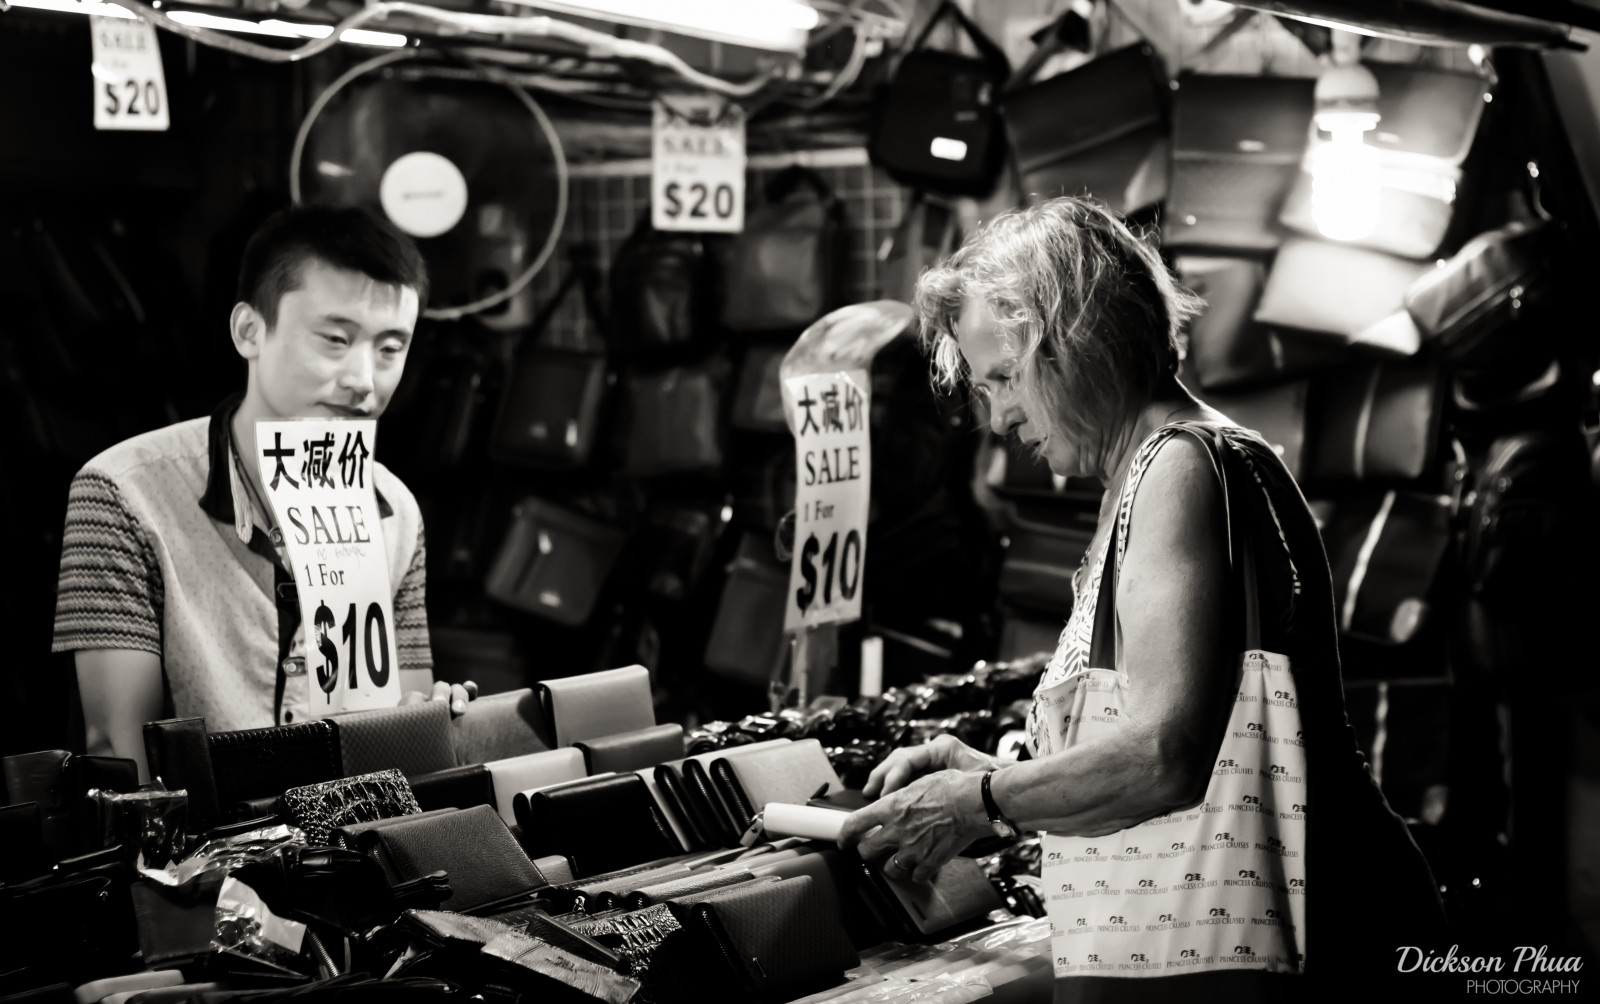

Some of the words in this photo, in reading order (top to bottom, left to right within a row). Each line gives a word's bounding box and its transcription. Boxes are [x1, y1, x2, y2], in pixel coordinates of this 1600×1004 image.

[104, 78, 161, 118] $20
[663, 182, 735, 220] $20
[797, 382, 865, 437] 大减价
[262, 430, 371, 492] 大减价
[804, 445, 862, 487] SALE
[814, 499, 835, 521] For
[286, 505, 371, 546] SALE
[304, 563, 314, 587] 1
[317, 563, 345, 586] For
[796, 528, 861, 619] $10
[313, 599, 391, 705] $10
[1232, 730, 1259, 739] PRINCESS
[1260, 733, 1281, 745] CRUISES
[1230, 767, 1254, 776] CRUISES
[1282, 774, 1303, 784] CRUISES
[1201, 805, 1223, 814] CRUISES
[1228, 804, 1254, 813] PRINCESS
[1279, 812, 1303, 821] PRINCESS
[1200, 842, 1225, 851] PRINCESS
[1225, 840, 1250, 850] CRUISES
[1125, 888, 1149, 896] PRINCESS
[1172, 882, 1197, 892] PRINCESS
[1223, 879, 1251, 888] PRINCESS
[1097, 924, 1119, 933] PRINCESS
[1145, 923, 1168, 932] PRINCESS
[1168, 920, 1192, 930] CRUISES
[1196, 917, 1221, 927] PRINCESS
[1221, 916, 1246, 925] CRUISES
[1118, 962, 1141, 971] PRINCESS
[1166, 959, 1191, 969] PRINCESS
[1191, 956, 1215, 966] CRUISES
[1219, 955, 1246, 963] PRINCESS
[1246, 955, 1270, 964] CRUISES
